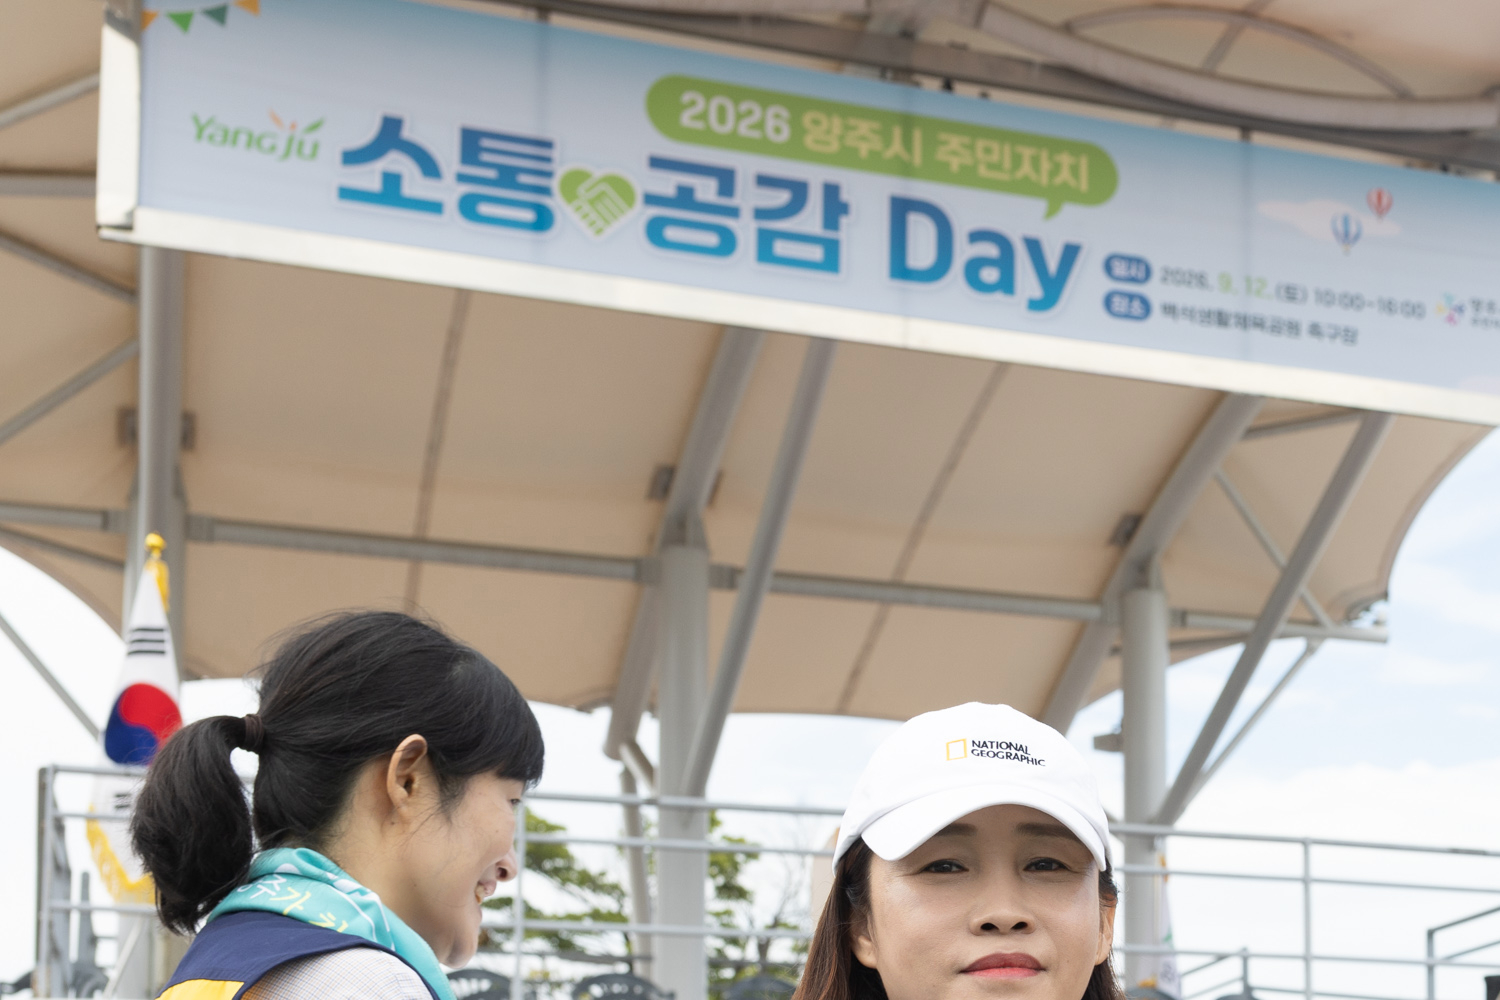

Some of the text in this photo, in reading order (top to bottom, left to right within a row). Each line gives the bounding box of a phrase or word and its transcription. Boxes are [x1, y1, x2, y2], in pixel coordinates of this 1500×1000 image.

[678, 90, 1090, 193] 2026 양주시 주민자치
[337, 114, 1082, 312] 소통 공감 Day
[971, 740, 1030, 755] NATIONAL
[971, 748, 1046, 767] GEOGRAPHIC
